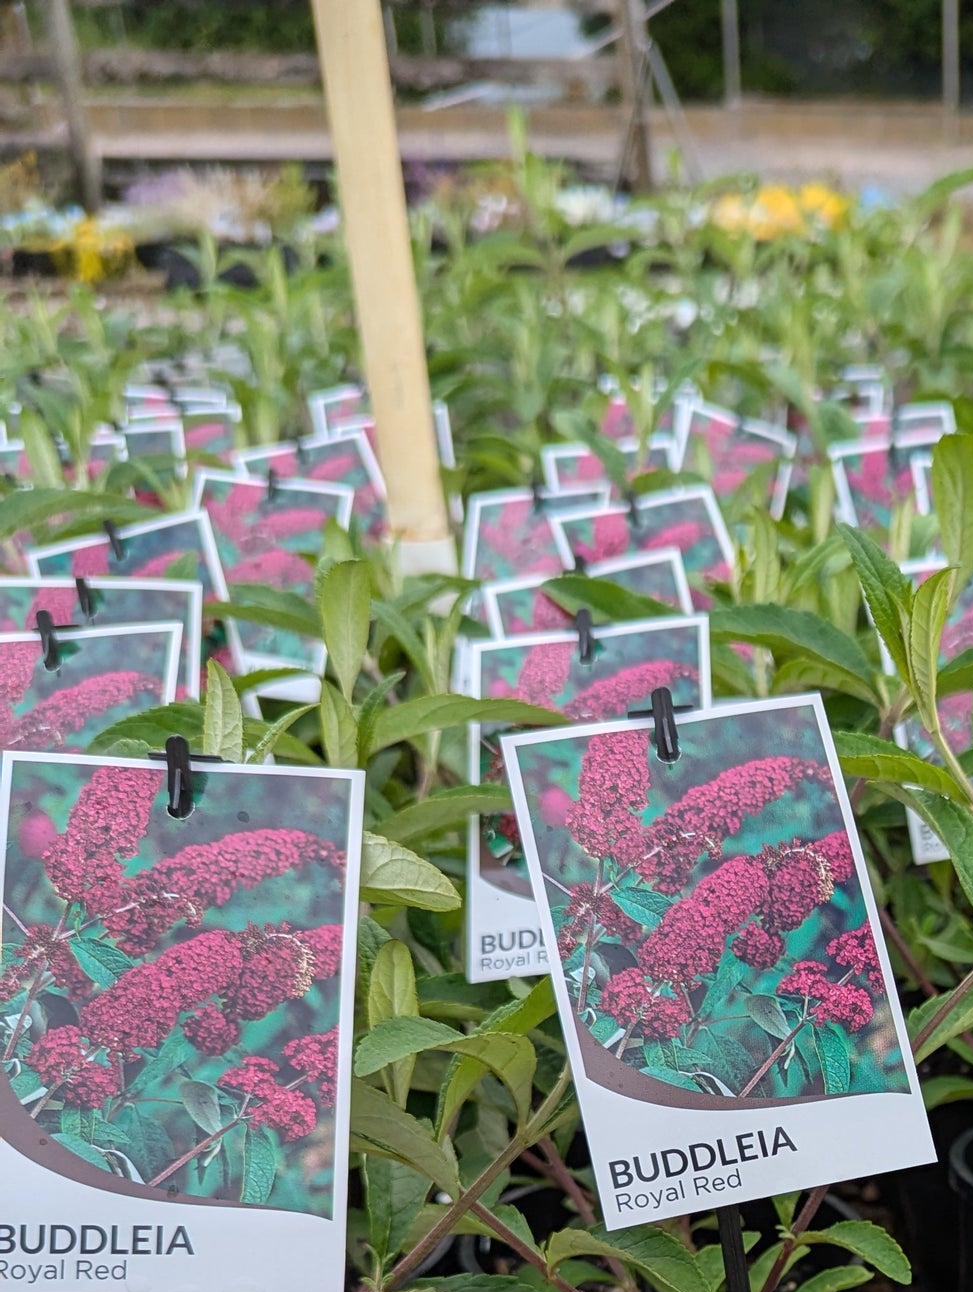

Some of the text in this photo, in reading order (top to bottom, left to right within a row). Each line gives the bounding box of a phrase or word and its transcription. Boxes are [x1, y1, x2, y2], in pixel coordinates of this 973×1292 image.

[481, 927, 546, 954] BUD
[481, 952, 530, 972] Royal
[608, 1126, 798, 1189] BUDDLEIA
[615, 1168, 742, 1213] Royal Red
[75, 1260, 127, 1280] Red
